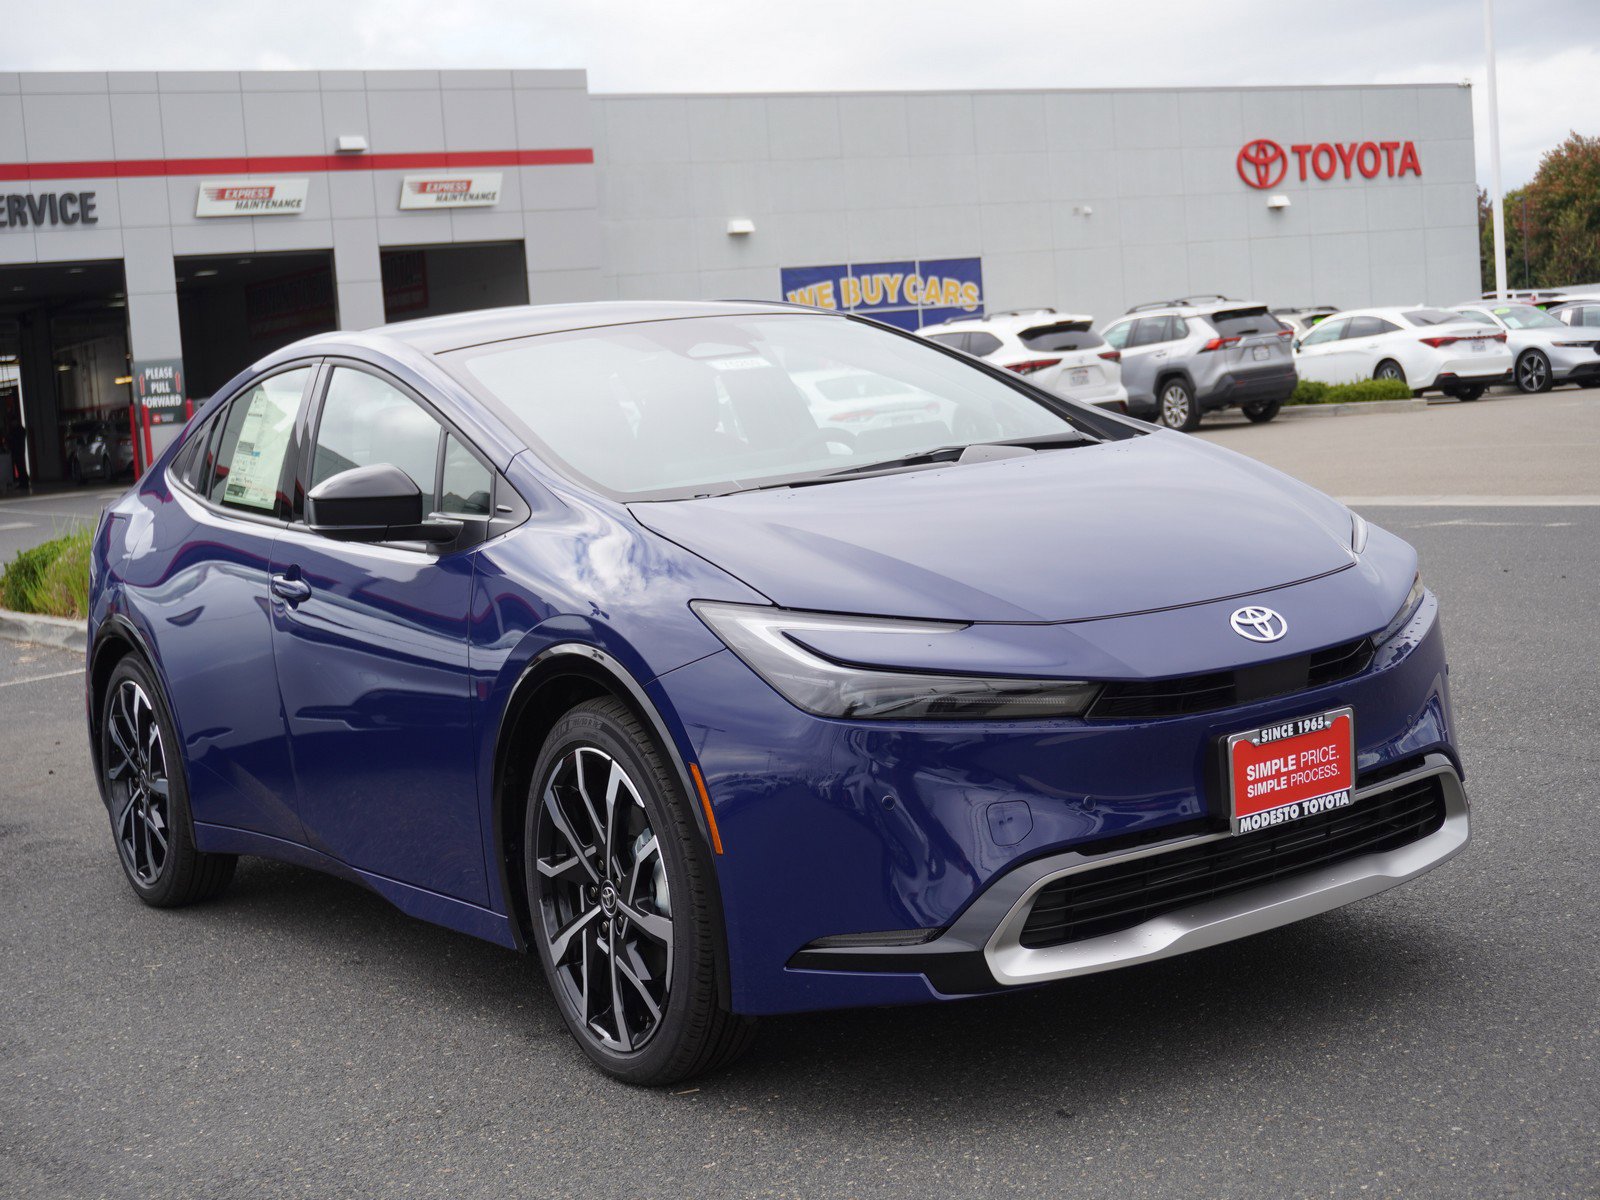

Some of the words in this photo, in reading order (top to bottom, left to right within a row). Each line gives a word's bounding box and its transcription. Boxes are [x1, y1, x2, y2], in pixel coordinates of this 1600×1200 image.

[1291, 142, 1422, 181] TOYOTA
[426, 182, 467, 192] EXPRESS
[224, 188, 271, 200] EXPRESS
[435, 191, 497, 202] MAINTENANCE
[235, 199, 302, 210] MAINTENANCE
[786, 280, 837, 309] WE
[839, 273, 904, 308] BUY
[903, 274, 980, 312] CARS
[145, 367, 173, 380] PLEASE
[151, 382, 170, 394] PULL
[142, 395, 181, 408] FORWARD
[1261, 724, 1294, 743] SINCE
[1297, 716, 1324, 734] 1965
[1246, 755, 1297, 781] SIMPLE
[1300, 744, 1340, 766] PRICE.
[1247, 776, 1288, 798] SIMPLE
[1290, 763, 1341, 787] PROCESS.
[1240, 804, 1299, 832] MODESTO
[1303, 792, 1349, 815] TOYOTA
